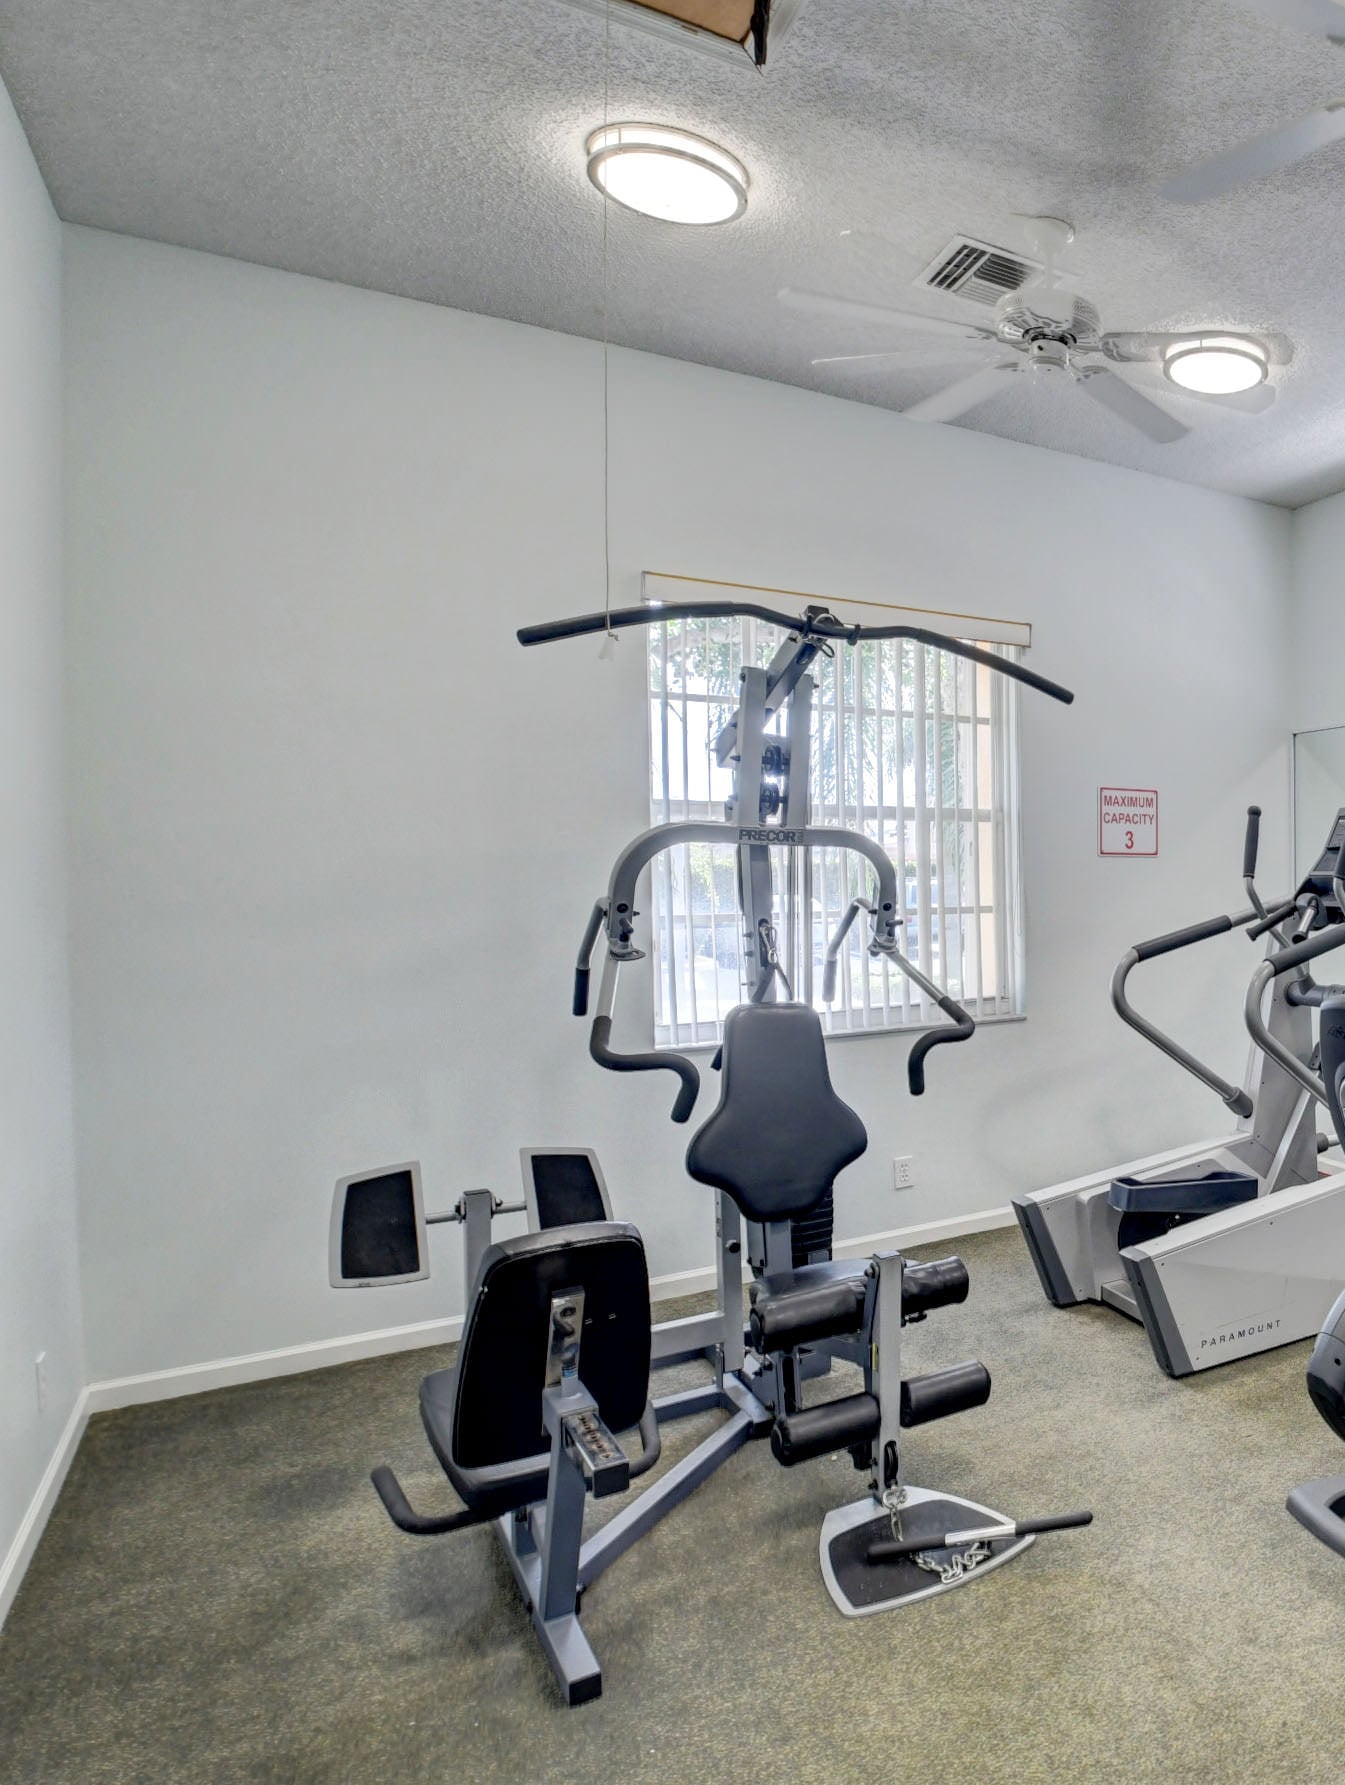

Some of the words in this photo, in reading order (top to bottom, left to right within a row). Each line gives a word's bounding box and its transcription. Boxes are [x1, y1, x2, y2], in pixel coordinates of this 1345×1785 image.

[1103, 795, 1154, 808] MAXIMUM
[1103, 812, 1154, 825] CAPACITY
[739, 829, 796, 842] PRECOR
[1125, 831, 1134, 849] 3
[1201, 1320, 1281, 1349] PARAMOUNT
